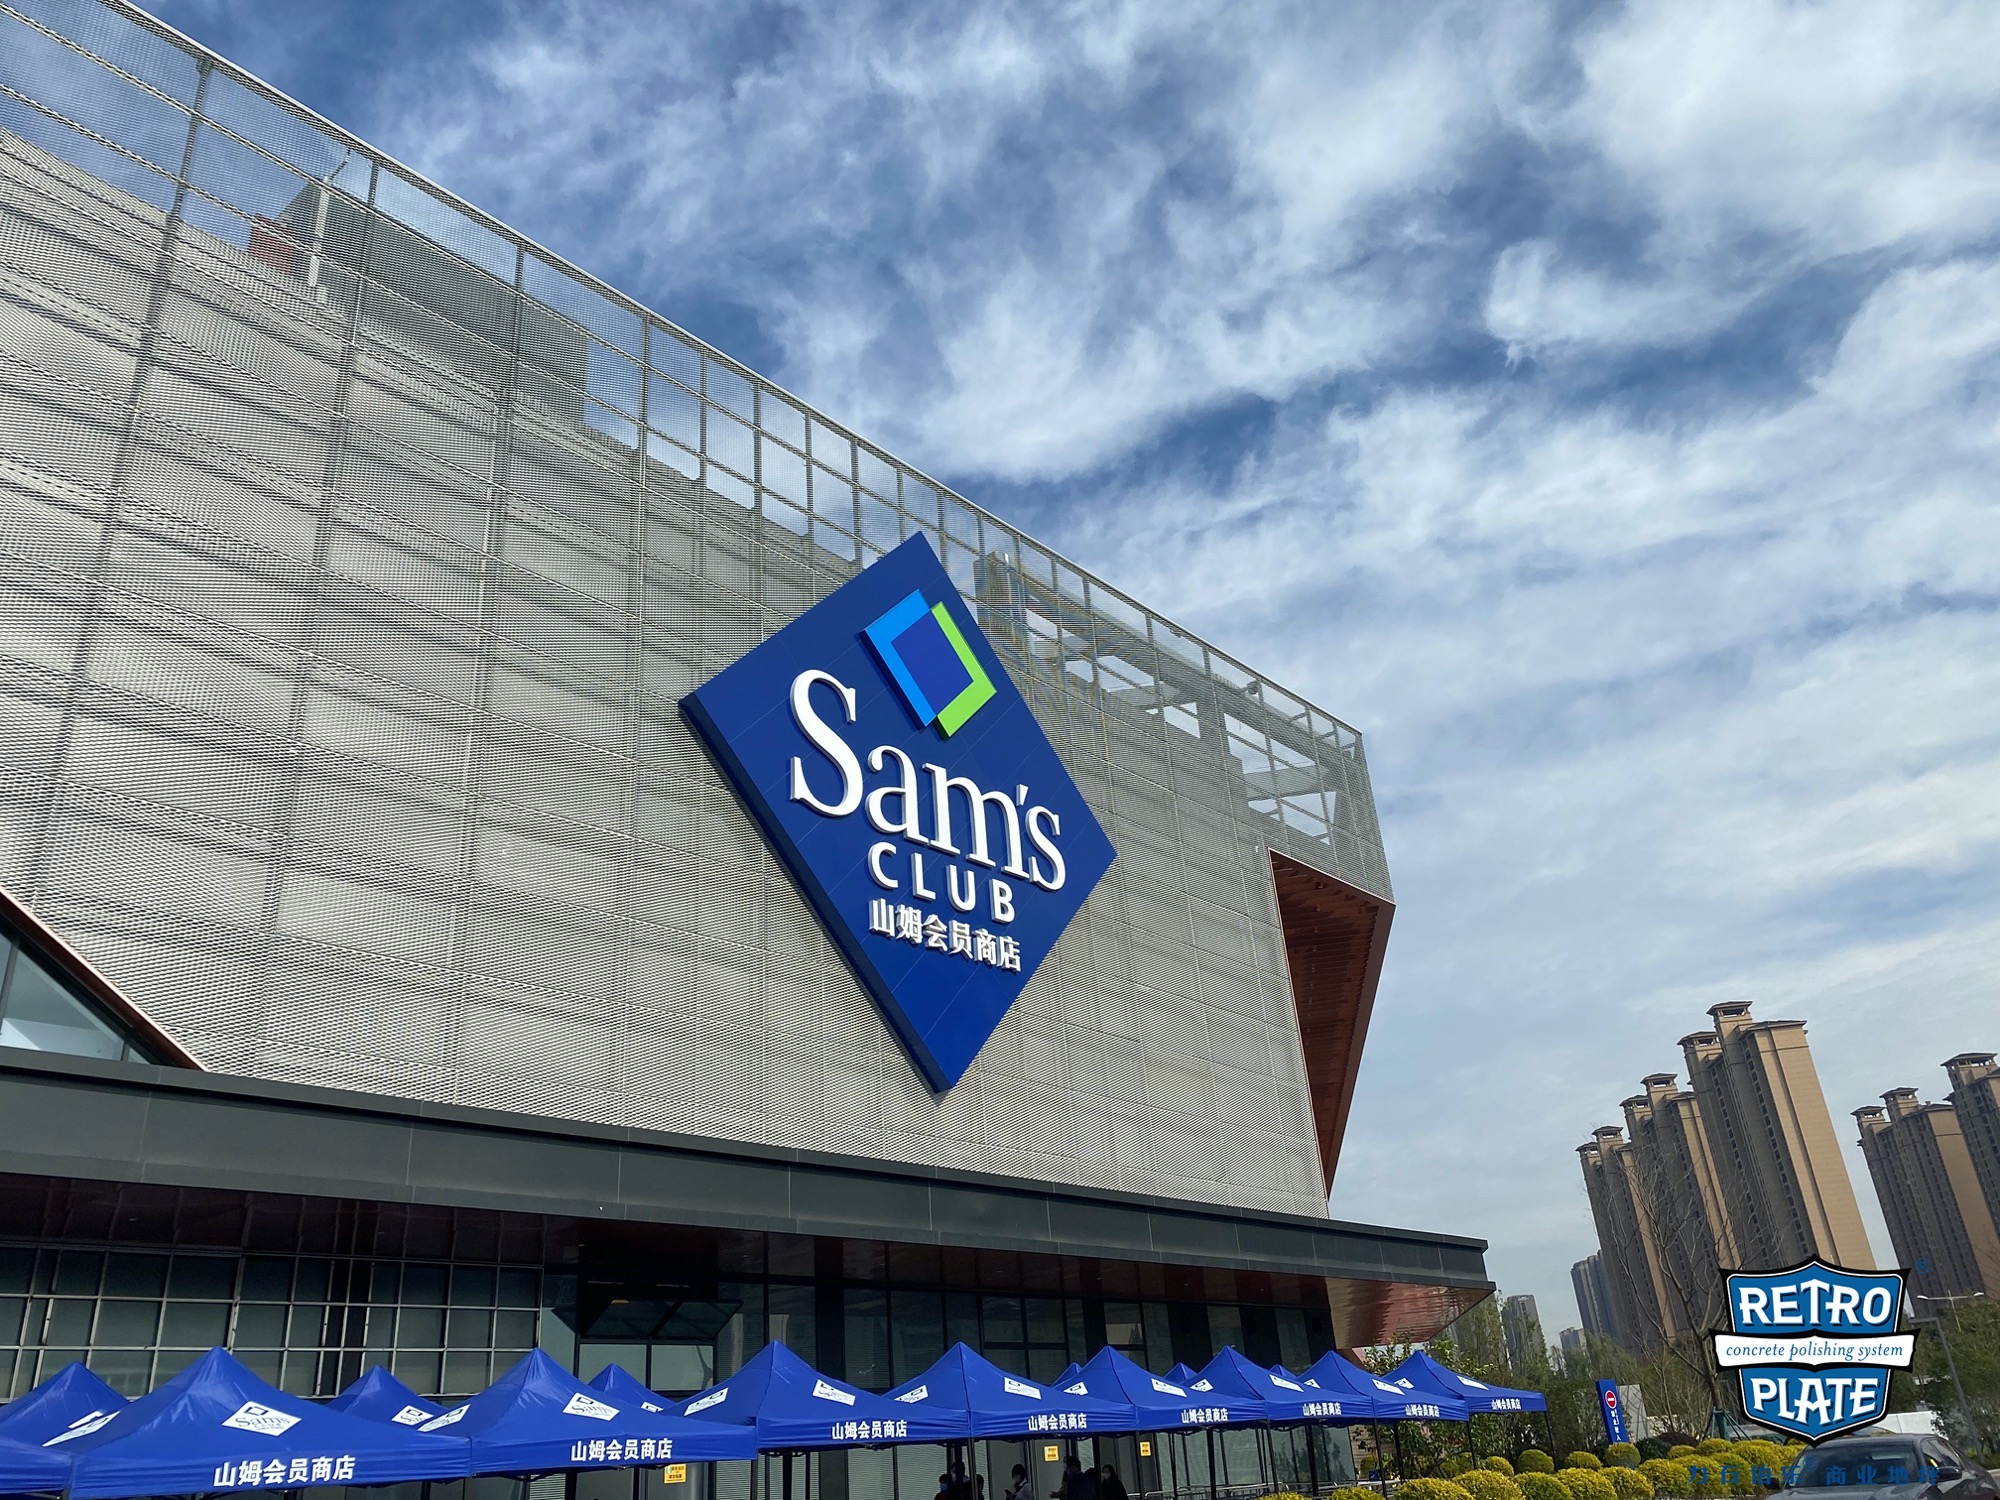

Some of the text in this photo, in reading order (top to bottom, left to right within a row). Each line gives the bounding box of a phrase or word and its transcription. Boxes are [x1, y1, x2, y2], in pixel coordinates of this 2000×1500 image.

[790, 669, 1067, 891] Sam's
[867, 841, 1017, 924] CLUB
[868, 897, 1022, 973] 山姆会员商店
[831, 1419, 908, 1440] 山姆会员商店
[1027, 1413, 1087, 1432] 山姆会员商店
[1181, 1408, 1229, 1424] 山姆会员商店
[570, 1437, 673, 1462] 山姆会员商店
[213, 1455, 356, 1487] 山姆会员商店
